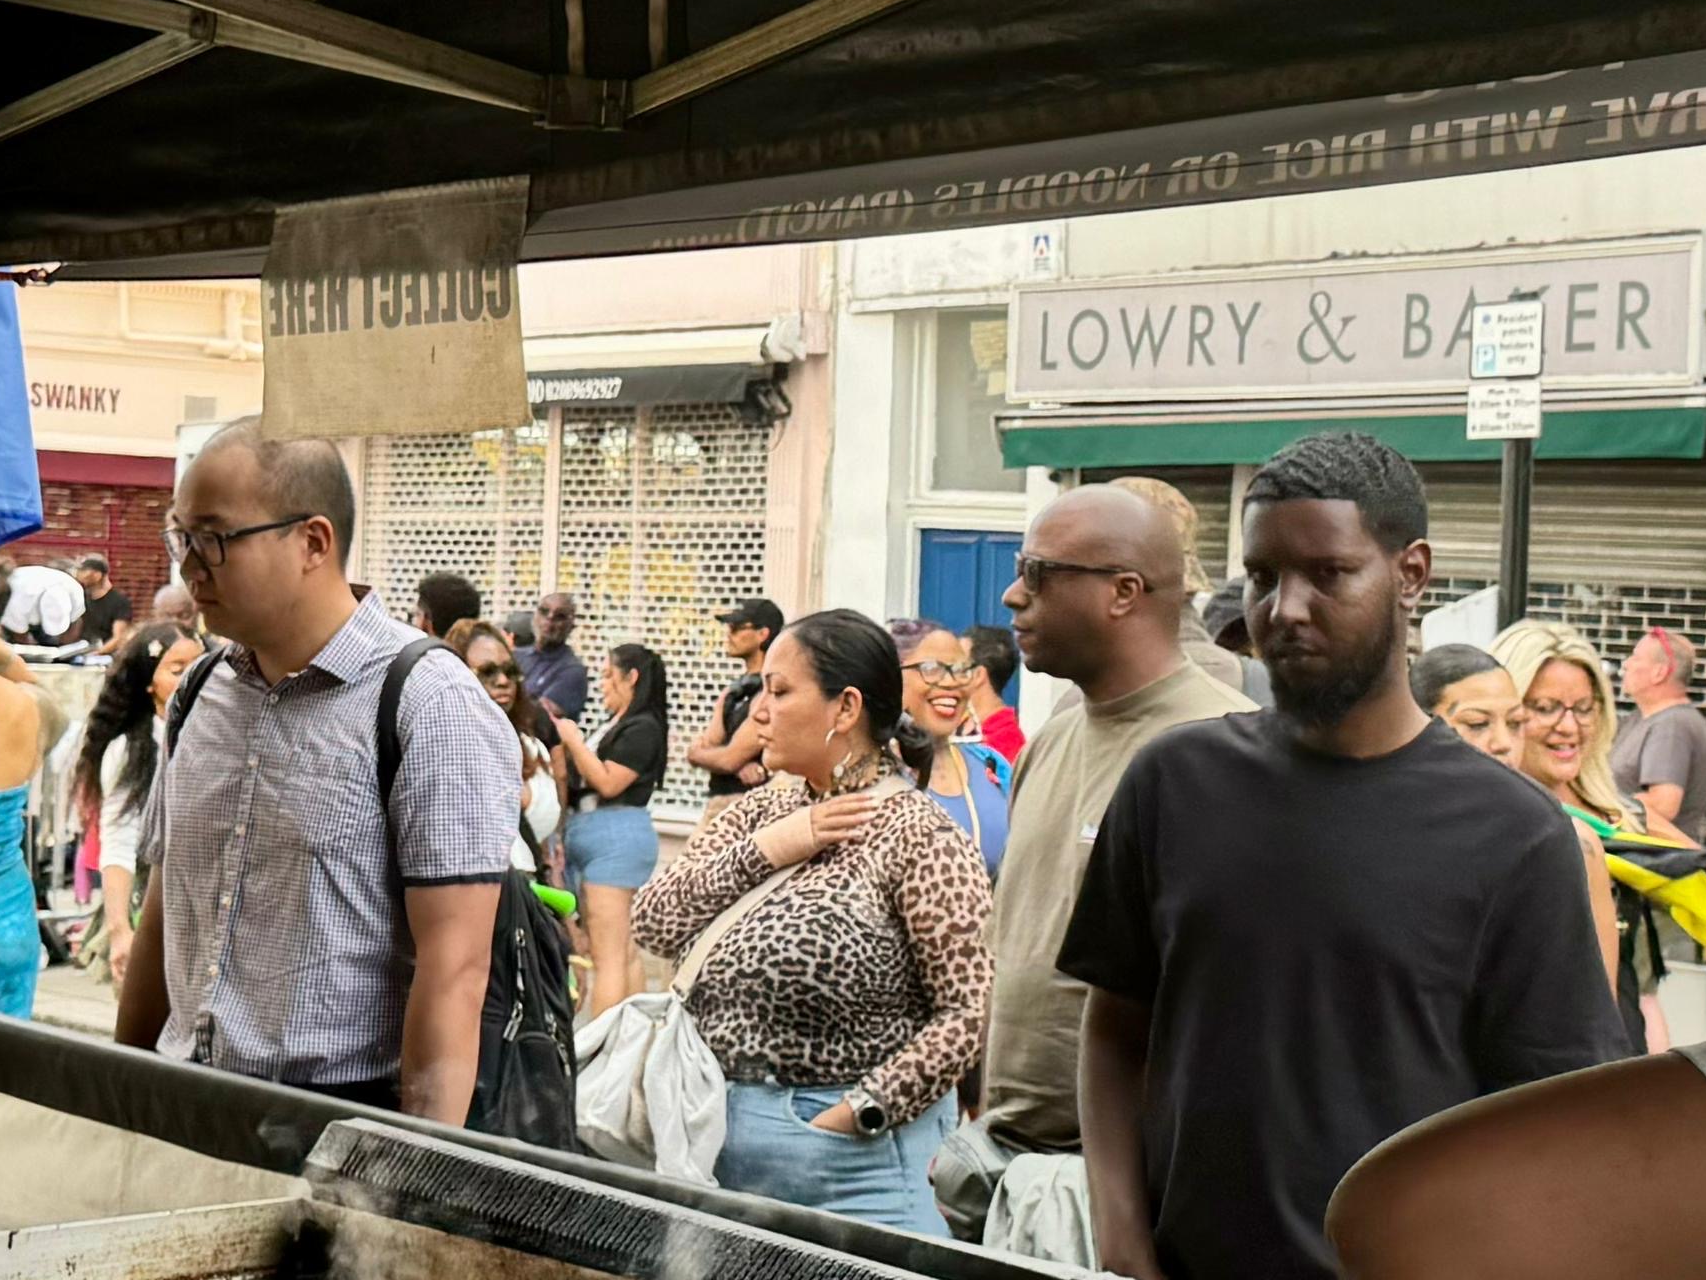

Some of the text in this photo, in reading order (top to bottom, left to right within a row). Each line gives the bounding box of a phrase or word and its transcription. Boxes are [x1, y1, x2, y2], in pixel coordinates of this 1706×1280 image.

[1041, 281, 1651, 370] LOWRY & BAER
[31, 382, 120, 414] SWANKY
